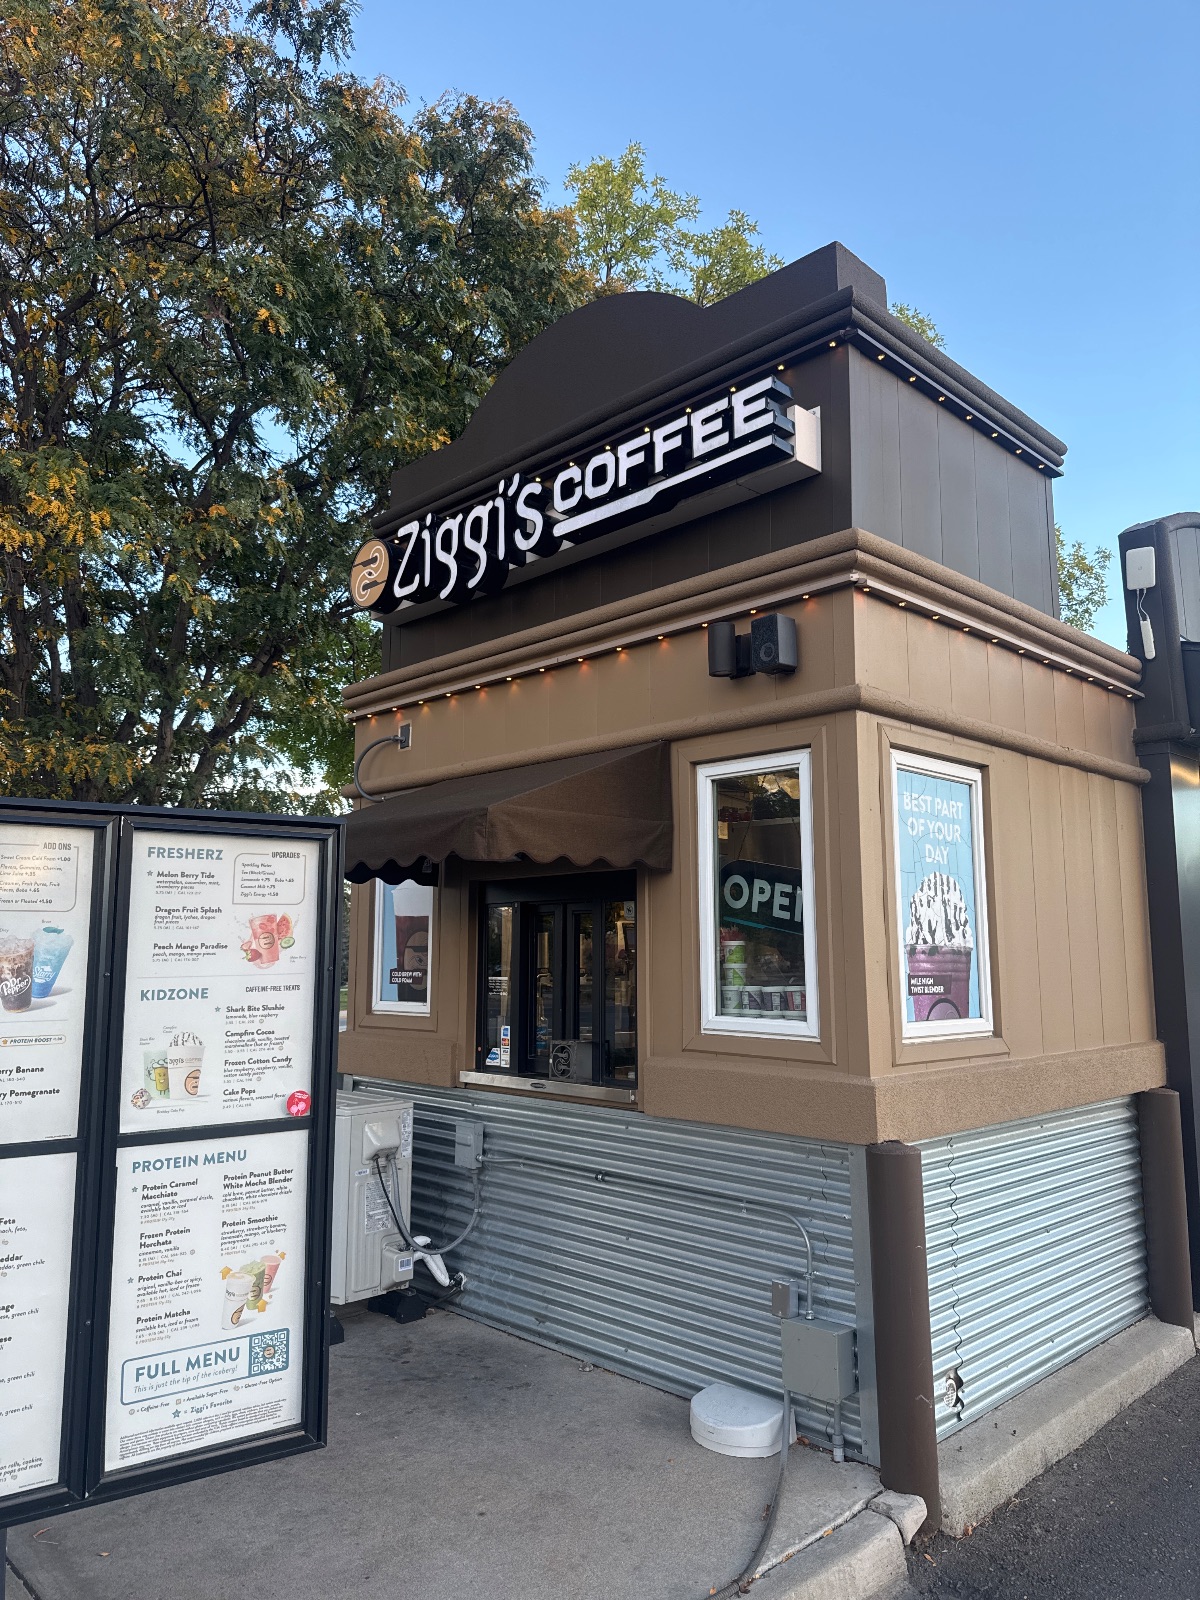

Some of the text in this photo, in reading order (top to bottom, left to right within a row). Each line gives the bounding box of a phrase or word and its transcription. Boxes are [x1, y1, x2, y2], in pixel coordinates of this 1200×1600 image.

[393, 375, 779, 599] Ziggi's COFFEE
[904, 792, 964, 819] BEST PART
[908, 817, 961, 842] OF YOUR
[43, 842, 56, 850] ADD
[148, 847, 223, 860] FRESHERZ
[925, 844, 949, 865] DAY
[180, 872, 199, 880] Berry
[155, 906, 180, 915] Dragon
[200, 906, 222, 915] Splash
[175, 943, 199, 952] Mango
[3, 978, 28, 996] Pepper
[9, 977, 21, 986] Dr
[140, 988, 209, 1001] KIDZONE
[225, 1030, 254, 1038] Campfire
[272, 1056, 292, 1064] Candy
[10, 1088, 60, 1098] Pomegranate
[132, 1150, 246, 1173] PROTEIN MENU
[224, 1173, 247, 1181] Protein
[249, 1170, 272, 1178] Peanut
[142, 1178, 198, 1191] Protein Caramel
[245, 1179, 266, 1187] Mocha
[268, 1176, 293, 1184] Blender
[142, 1191, 177, 1200] Macchiato
[222, 1214, 278, 1228] Protein Smoothie
[165, 1227, 190, 1236] Protein
[140, 1240, 172, 1249] Horchata
[138, 1269, 182, 1283] Protein Chai
[136, 1309, 190, 1324] Protein Matcha
[135, 1346, 240, 1382] FULL MENU
[7, 1374, 22, 1383] green
[134, 1385, 147, 1393] This
[154, 1380, 168, 1391] just
[182, 1376, 191, 1384] tip
[193, 1372, 200, 1381] of
[202, 1370, 211, 1379] the
[213, 1365, 238, 1378] iceberg!
[5, 1407, 20, 1416] green
[141, 1402, 170, 1412] Caffeine-Free
[190, 1399, 232, 1413] Ziggi's Favorite
